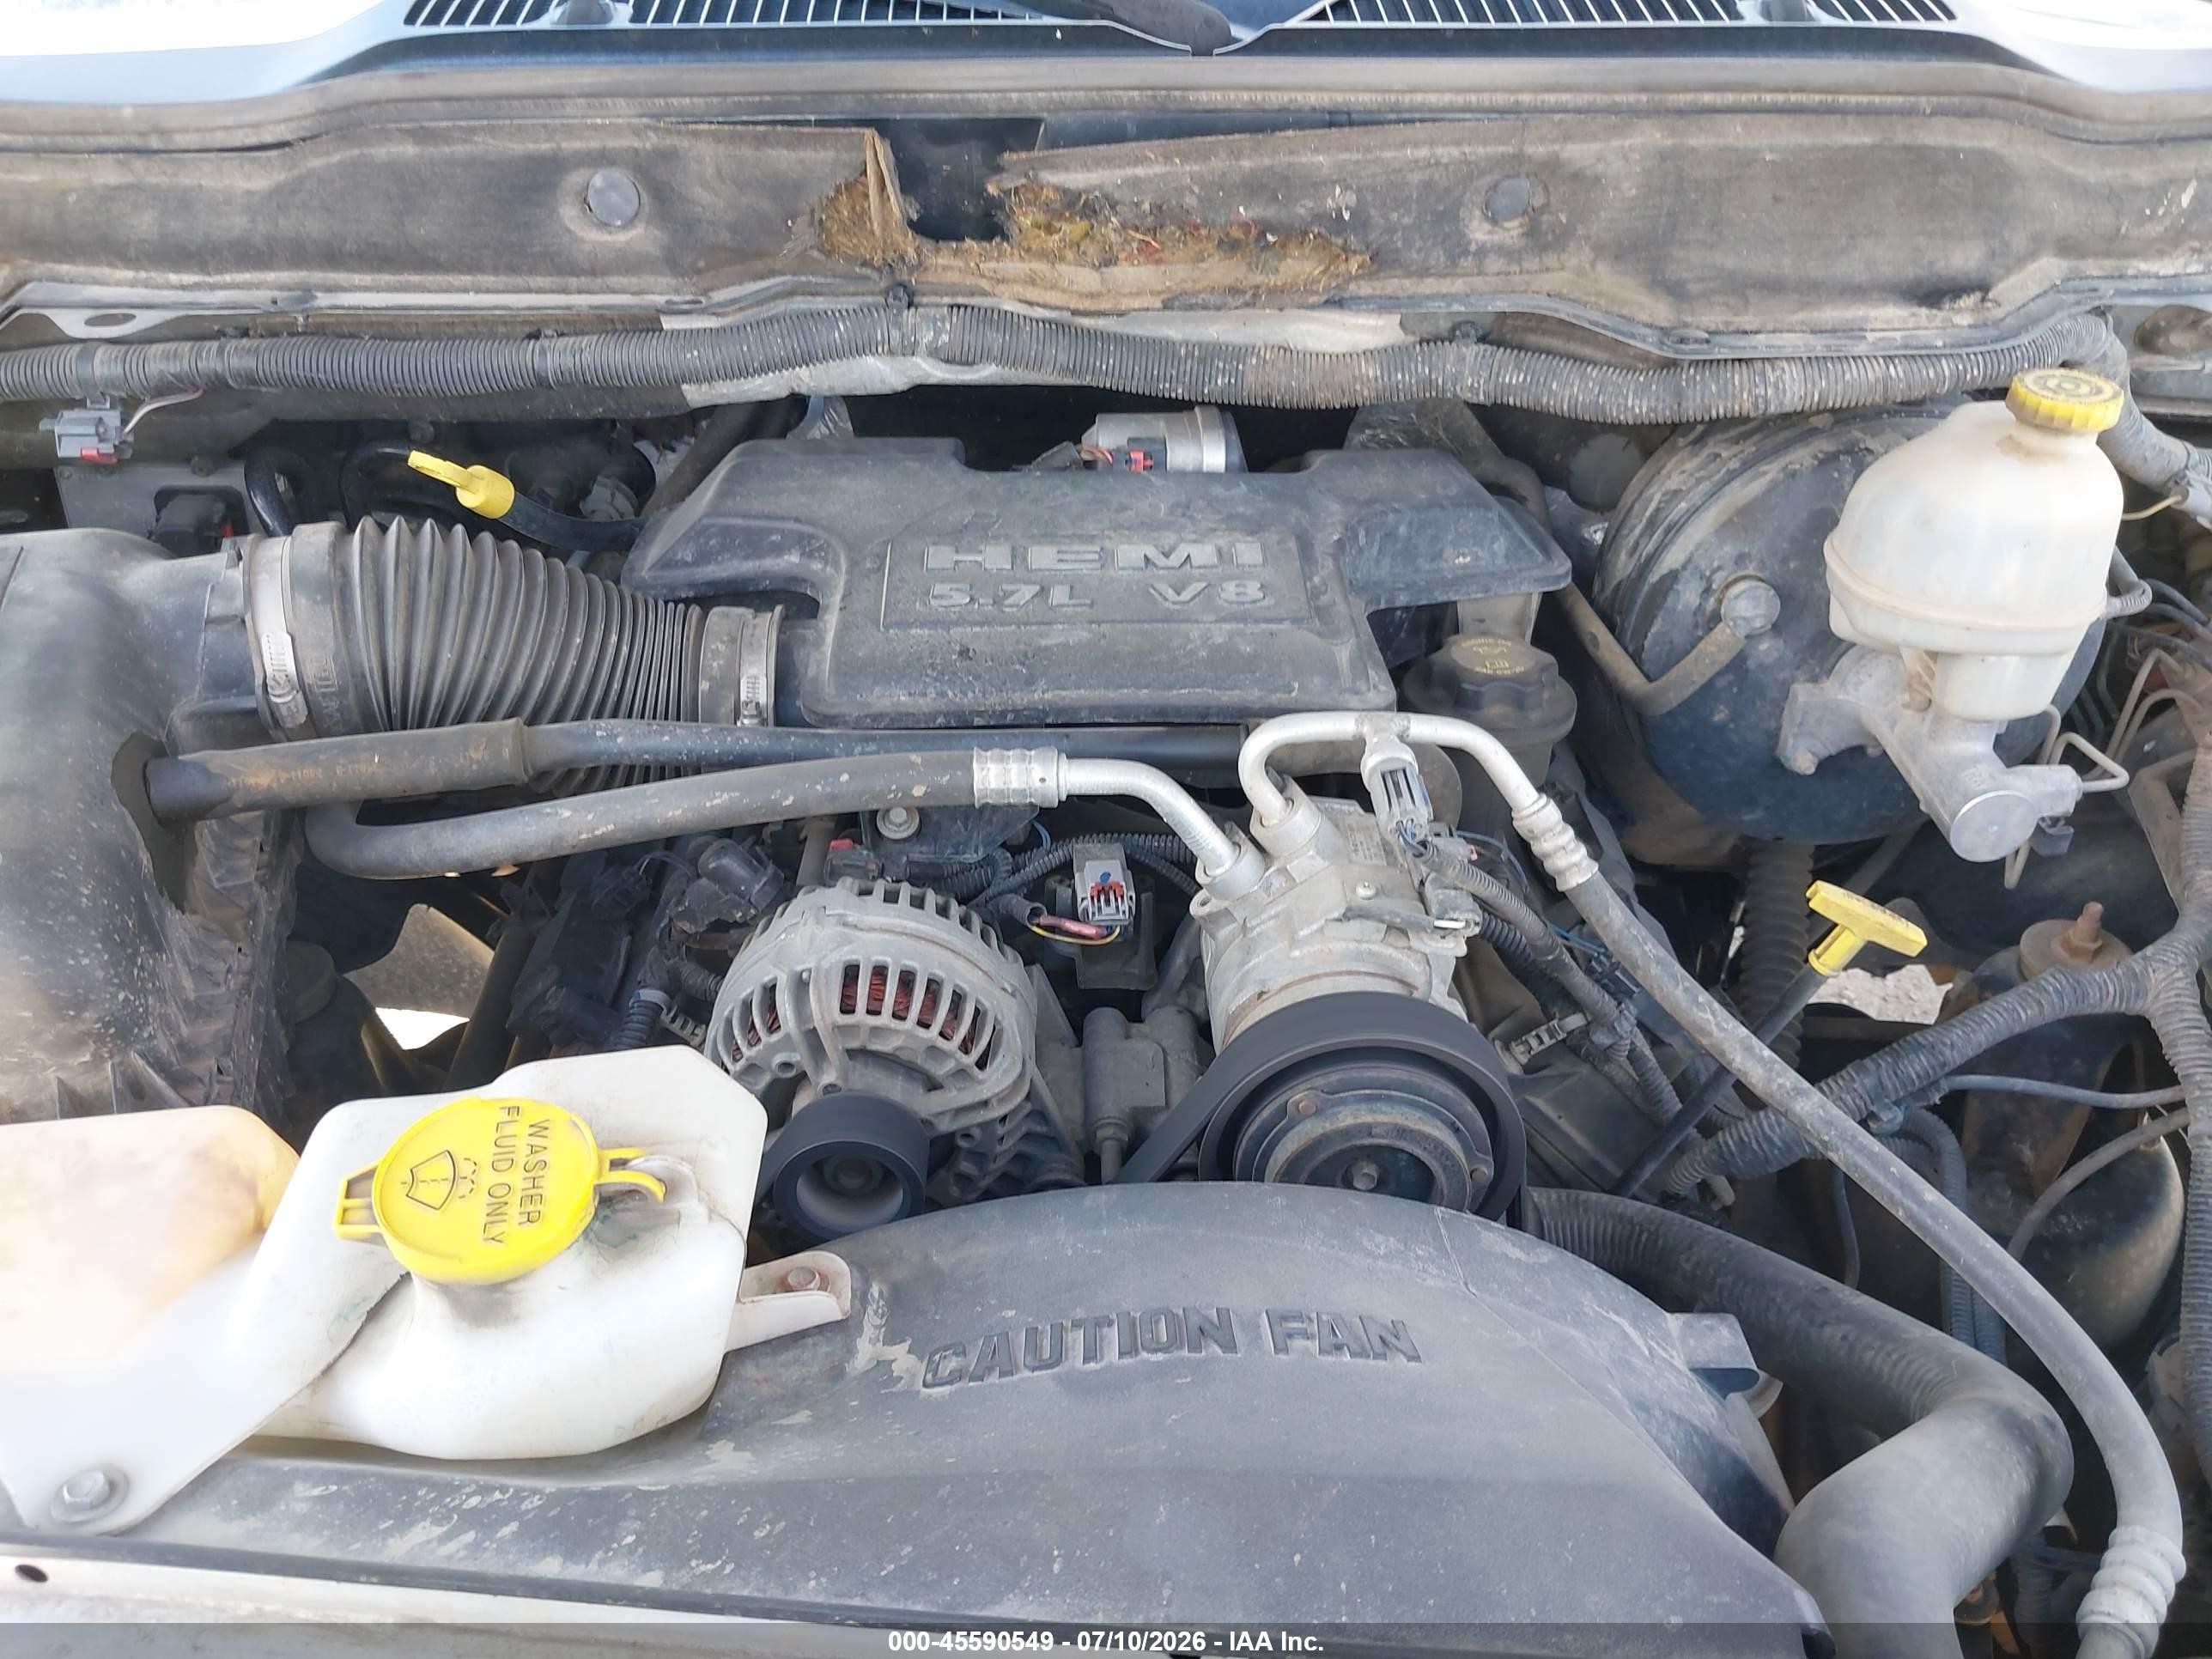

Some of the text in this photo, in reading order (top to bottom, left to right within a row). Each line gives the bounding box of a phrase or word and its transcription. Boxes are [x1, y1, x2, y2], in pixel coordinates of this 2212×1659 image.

[924, 543, 1265, 571] HEMI
[928, 580, 1267, 611] 5.7L V8
[483, 1105, 520, 1244] FLUID ONLY
[518, 1118, 550, 1226] WASHER
[921, 1305, 1422, 1390] CAUTION FAN
